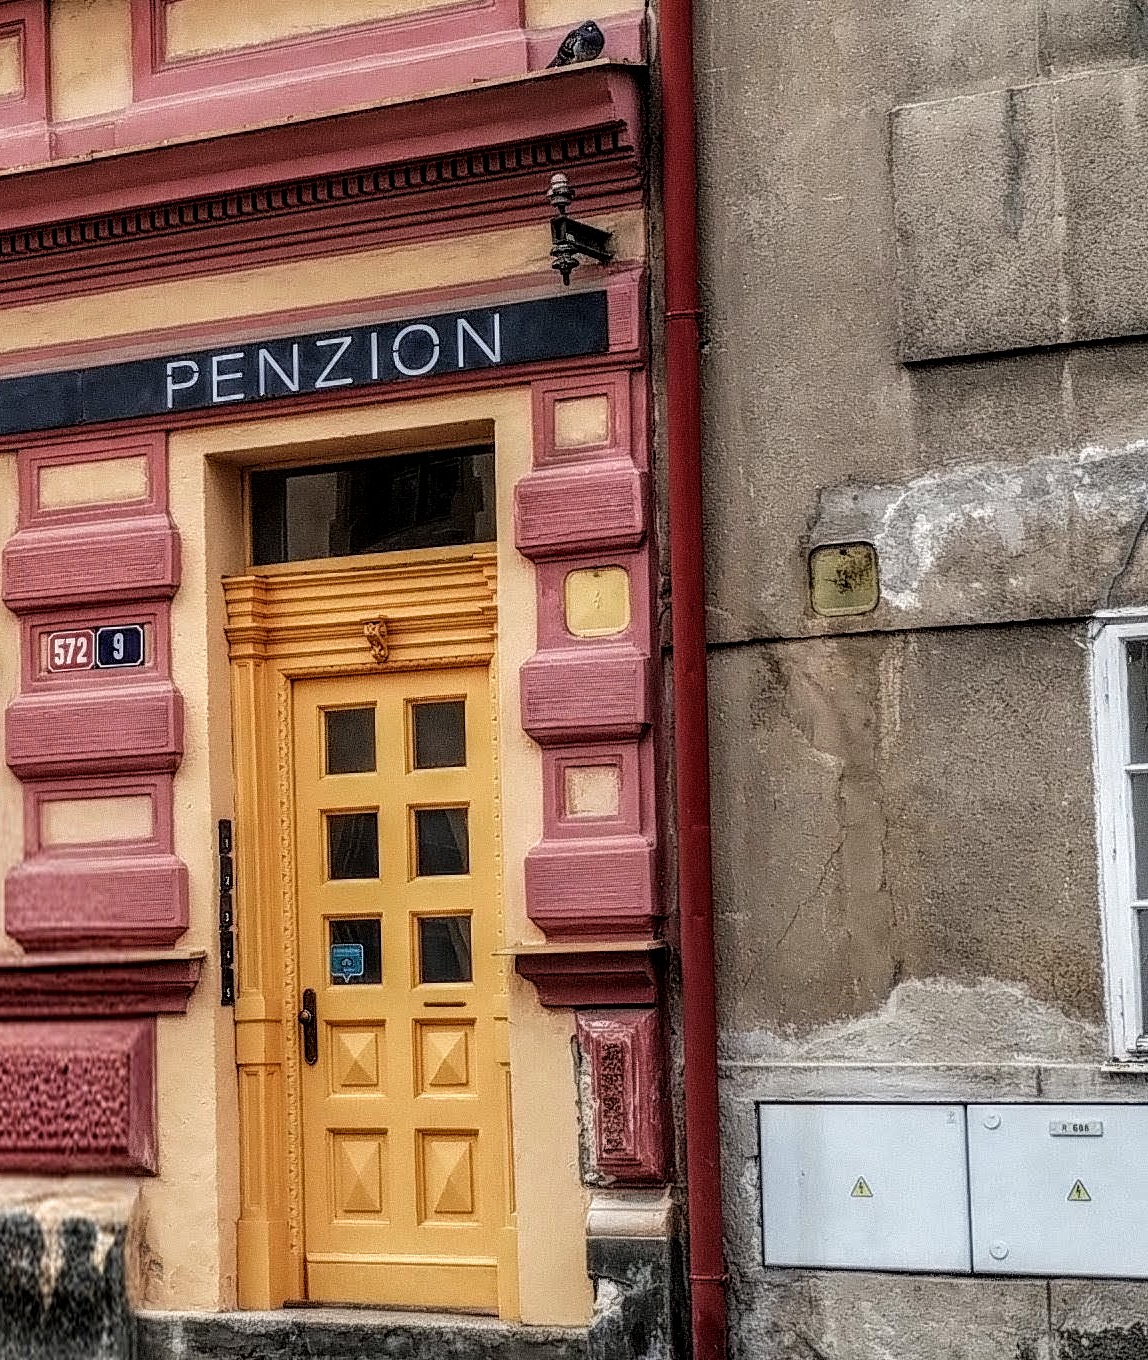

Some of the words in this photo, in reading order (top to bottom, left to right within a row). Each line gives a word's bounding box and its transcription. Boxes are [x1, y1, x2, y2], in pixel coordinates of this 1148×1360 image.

[165, 312, 502, 409] PENZION
[54, 636, 88, 666] 572
[113, 632, 125, 660] 9
